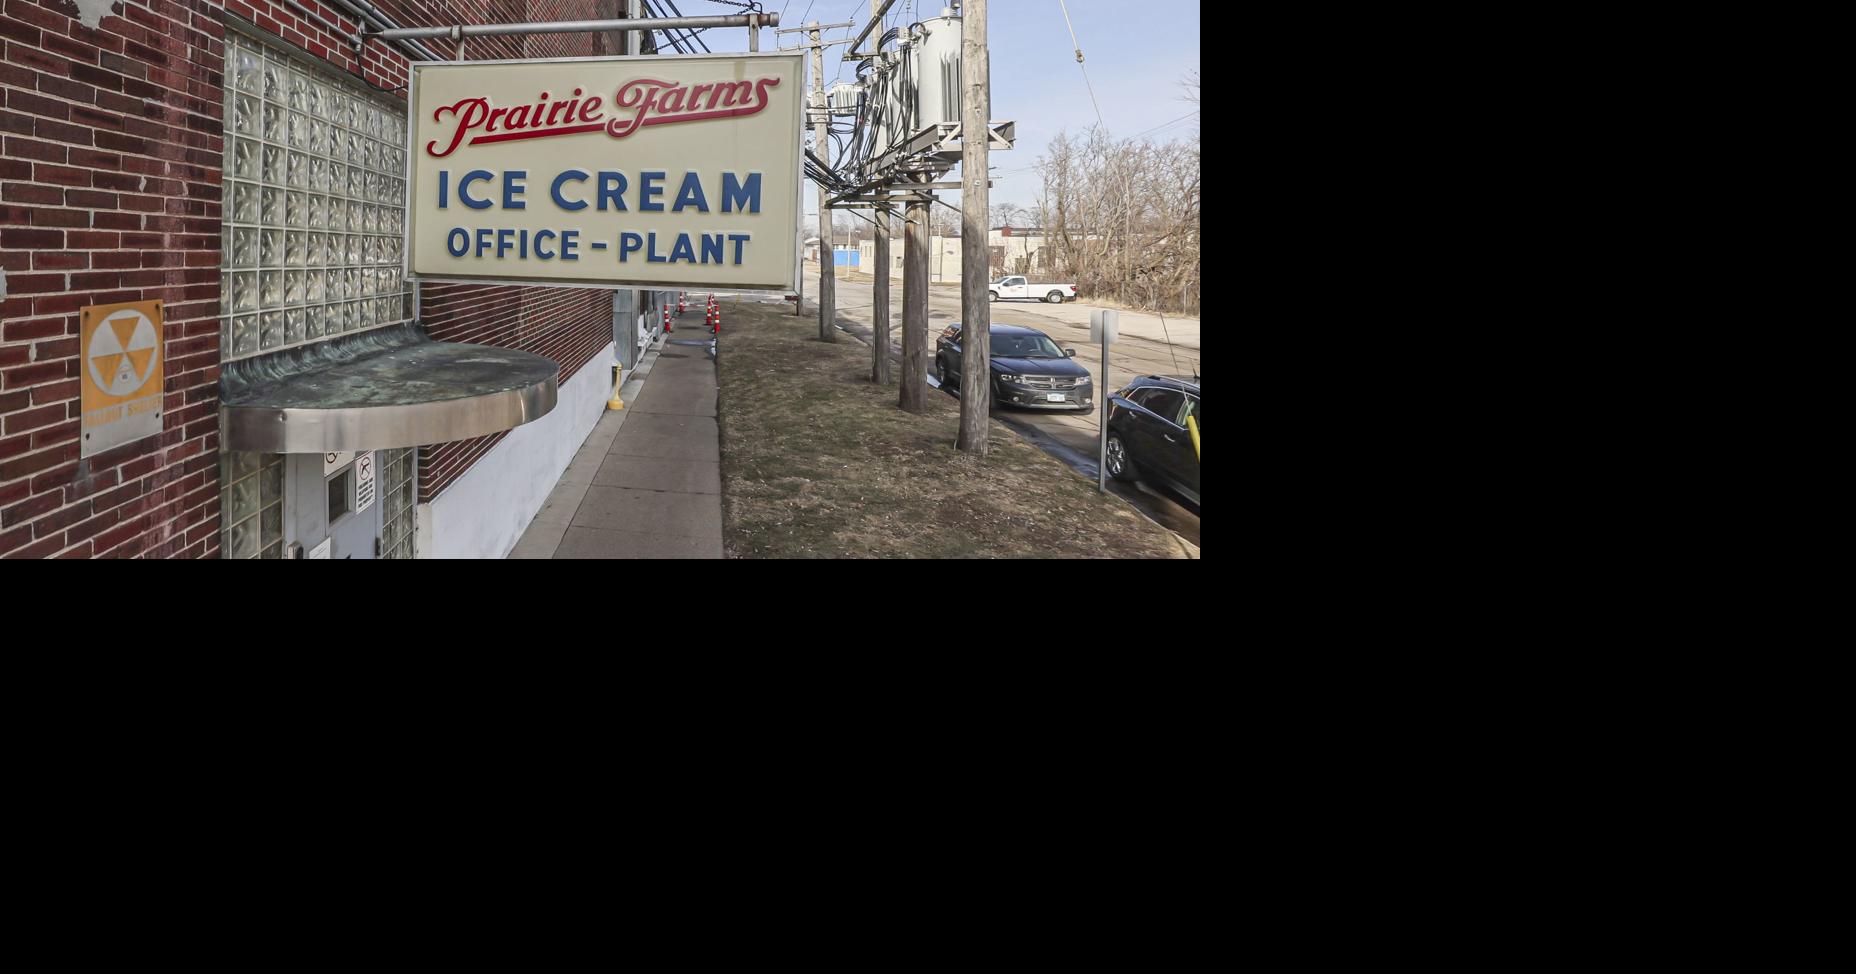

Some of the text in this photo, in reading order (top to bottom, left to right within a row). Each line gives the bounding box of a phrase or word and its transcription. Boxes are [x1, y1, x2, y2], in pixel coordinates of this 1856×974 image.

[426, 77, 781, 158] Prairie Farms
[438, 169, 763, 214] ICE CREAM
[447, 227, 580, 261] OFFICE
[619, 232, 751, 265] PLANT
